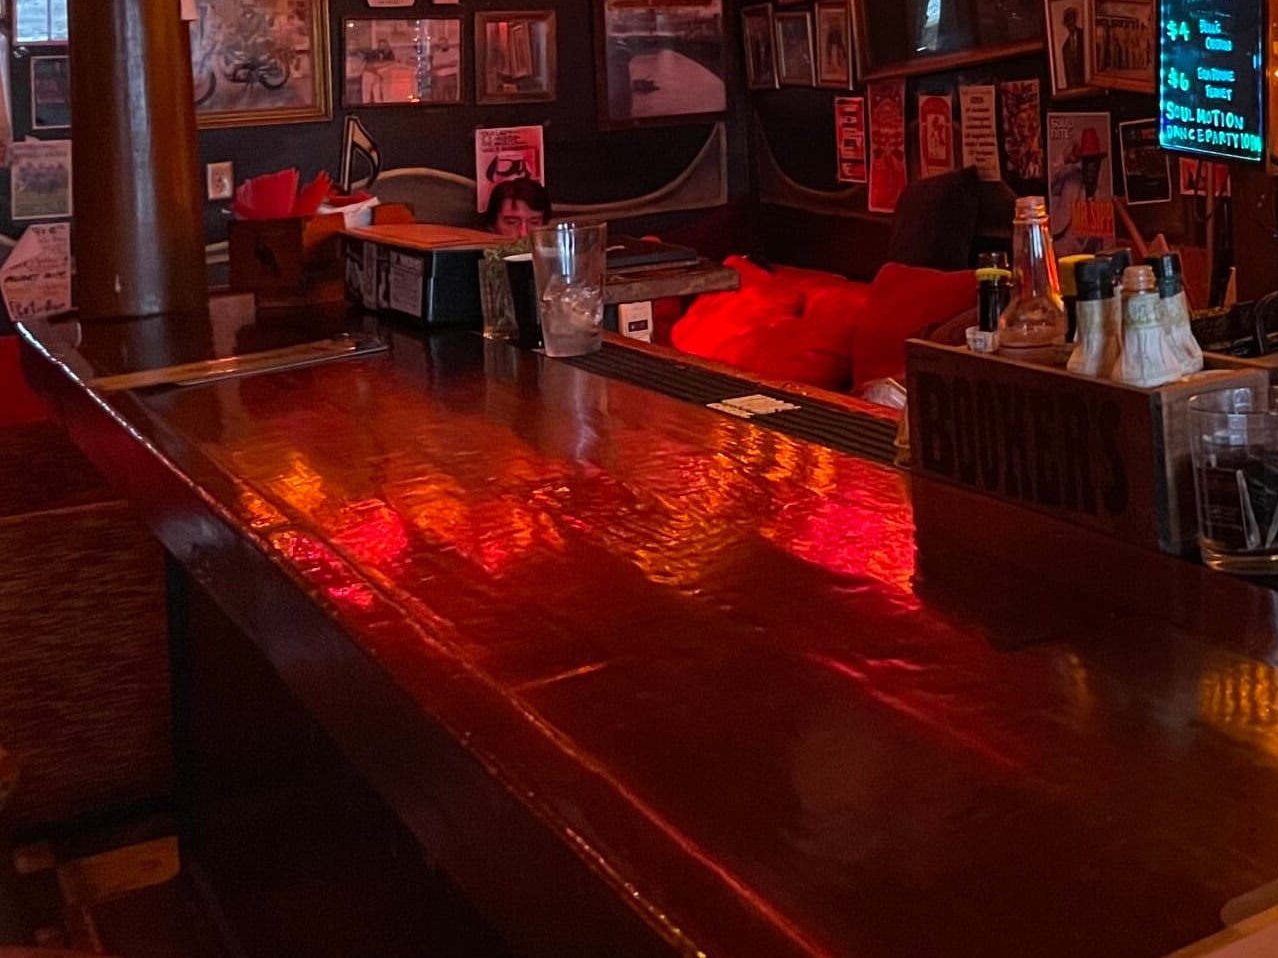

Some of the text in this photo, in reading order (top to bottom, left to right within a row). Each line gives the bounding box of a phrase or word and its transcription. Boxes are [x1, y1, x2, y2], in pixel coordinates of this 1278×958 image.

[1166, 20, 1190, 42] $4
[1167, 67, 1190, 92] $6
[1165, 101, 1245, 131] SOUL MOTION
[1205, 129, 1239, 150] PARTY
